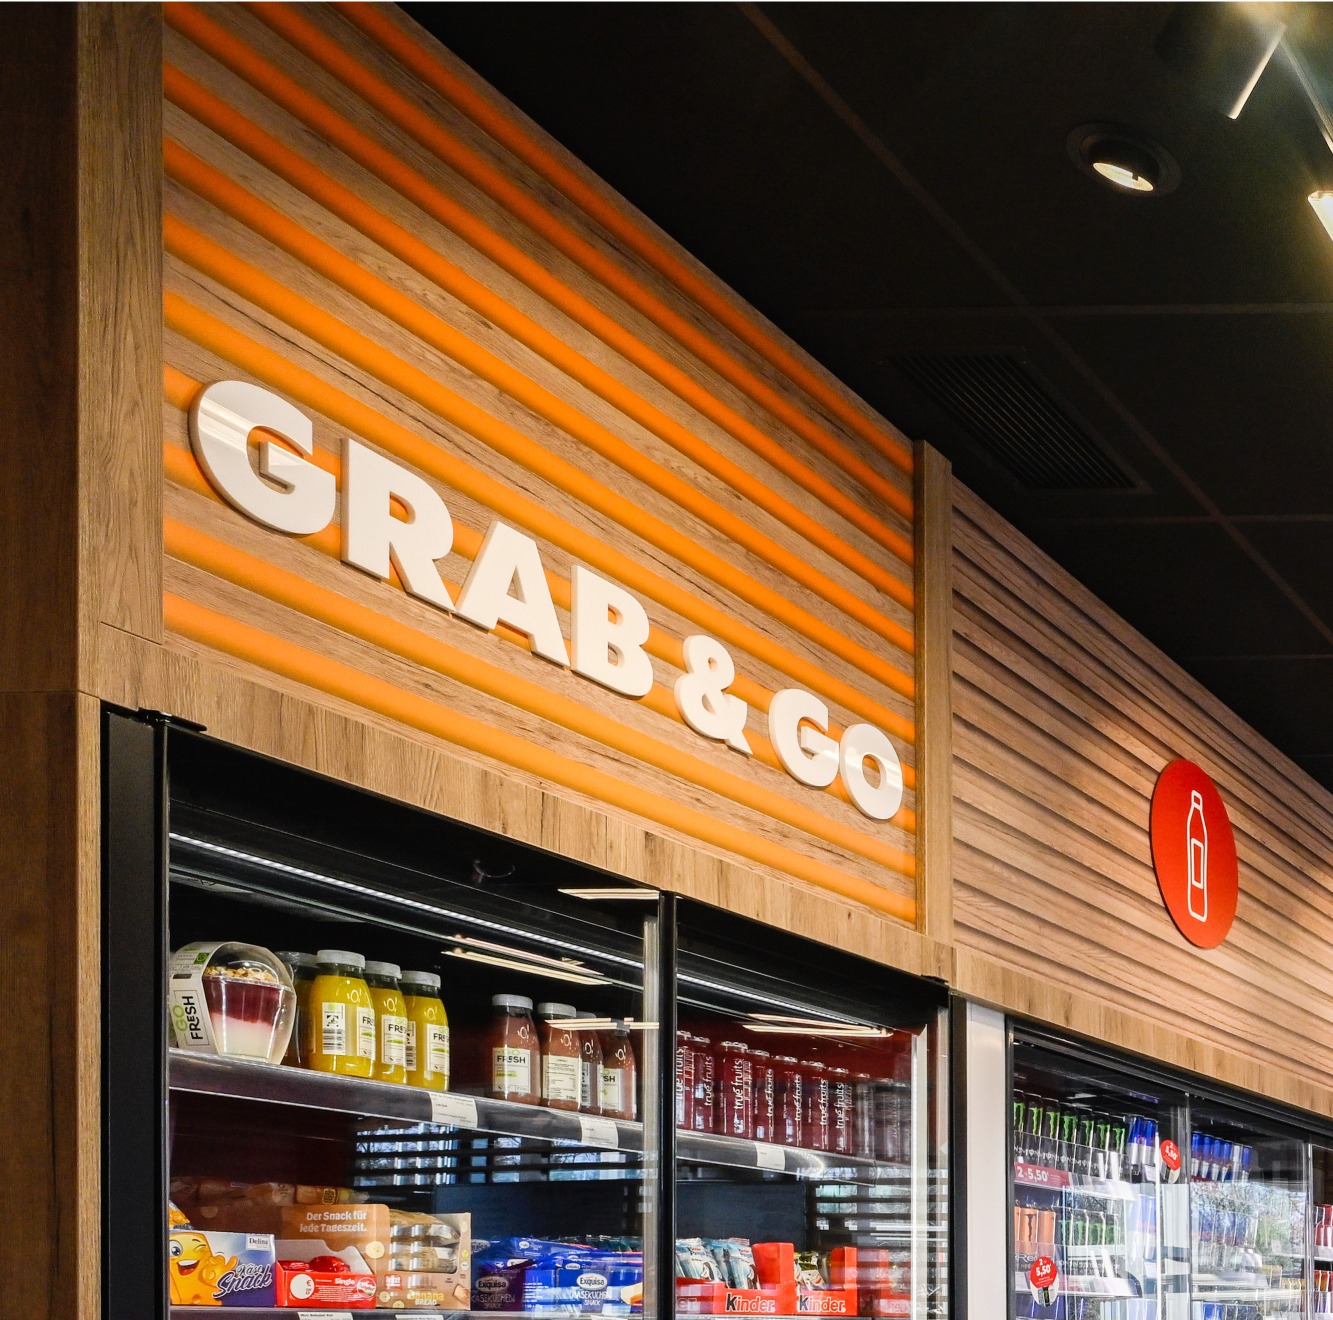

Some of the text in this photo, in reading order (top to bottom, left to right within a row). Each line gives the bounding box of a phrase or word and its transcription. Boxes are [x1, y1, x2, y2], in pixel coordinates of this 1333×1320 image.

[188, 380, 905, 820] GRAB & GO
[182, 996, 203, 1040] FRESH
[496, 1055, 526, 1064] FRESH
[733, 1058, 744, 1110] true fruits
[1016, 1166, 1025, 1178] 2
[323, 1211, 352, 1221] Snack
[353, 1211, 367, 1221] für
[211, 1271, 272, 1299] Snack
[579, 1277, 605, 1287] Exquisa
